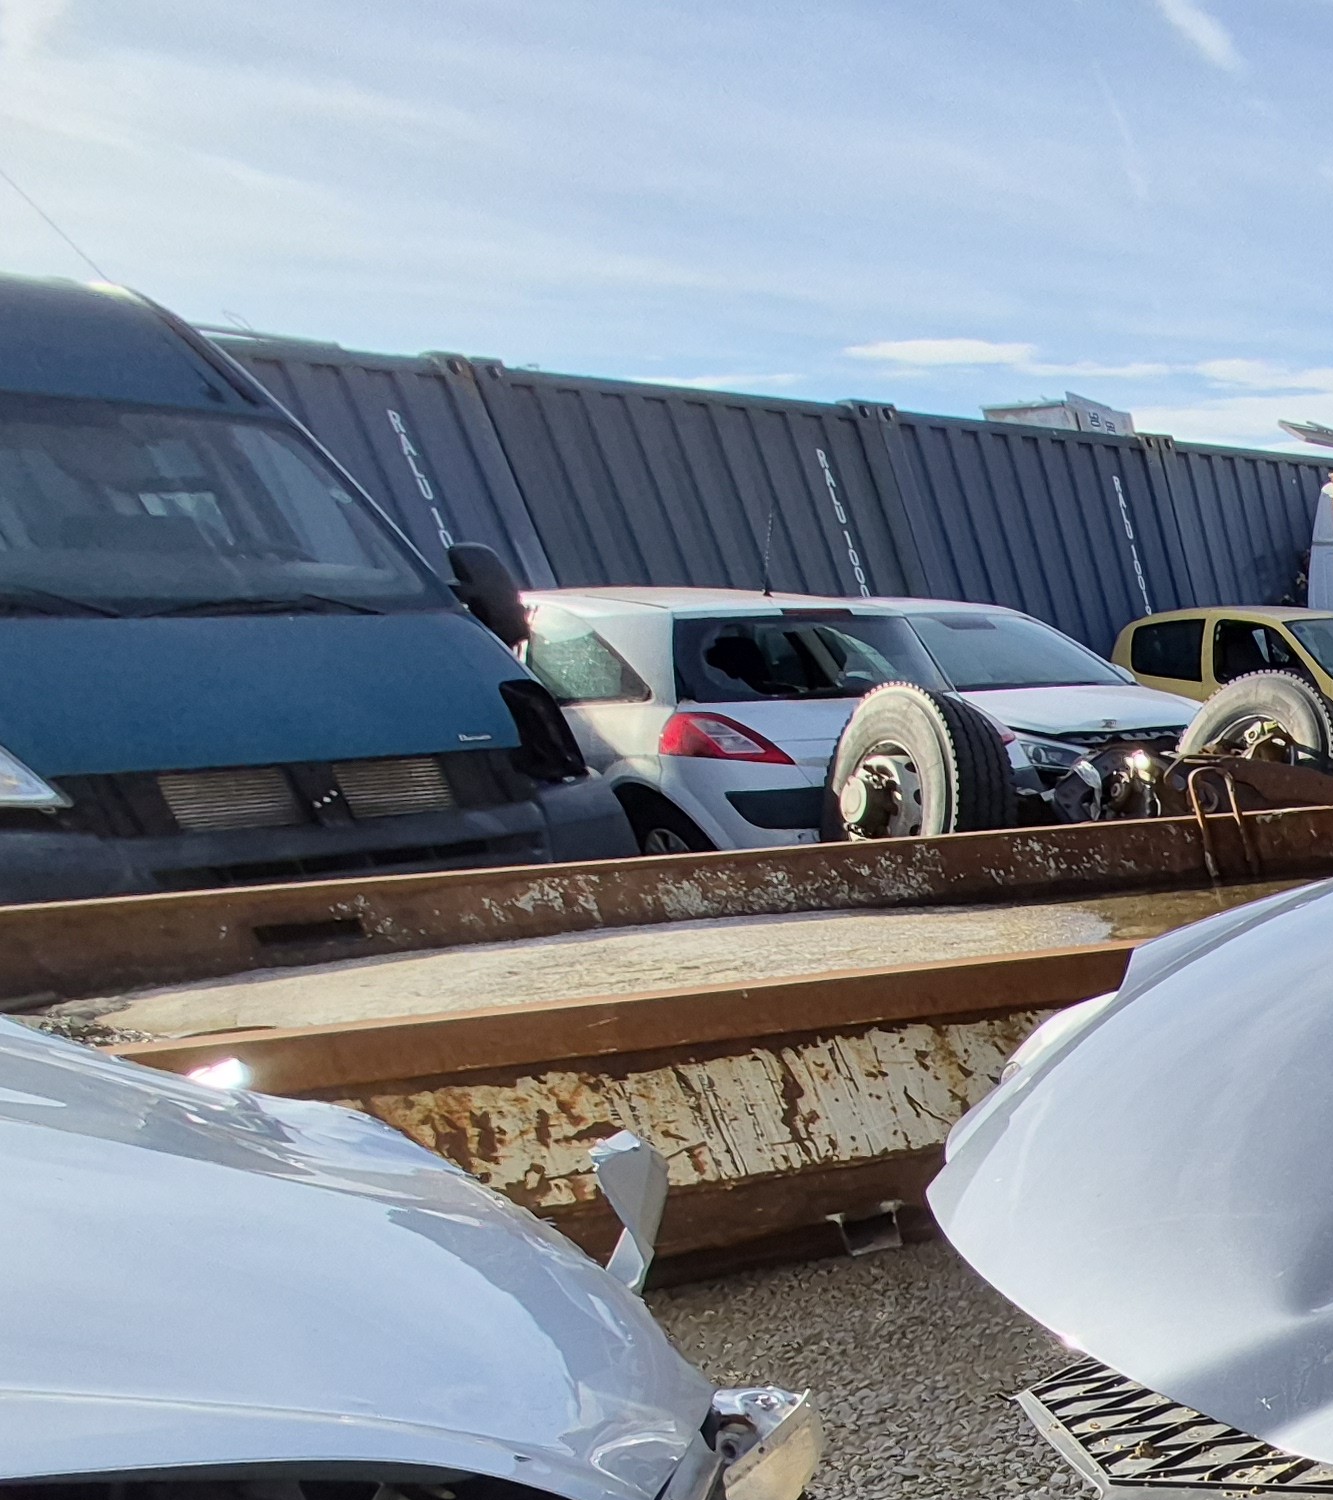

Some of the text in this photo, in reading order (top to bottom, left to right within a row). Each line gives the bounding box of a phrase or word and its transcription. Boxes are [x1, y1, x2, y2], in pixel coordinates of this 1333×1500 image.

[387, 409, 434, 500] RALU
[815, 448, 847, 524] RALU
[1112, 475, 1134, 540] RALU
